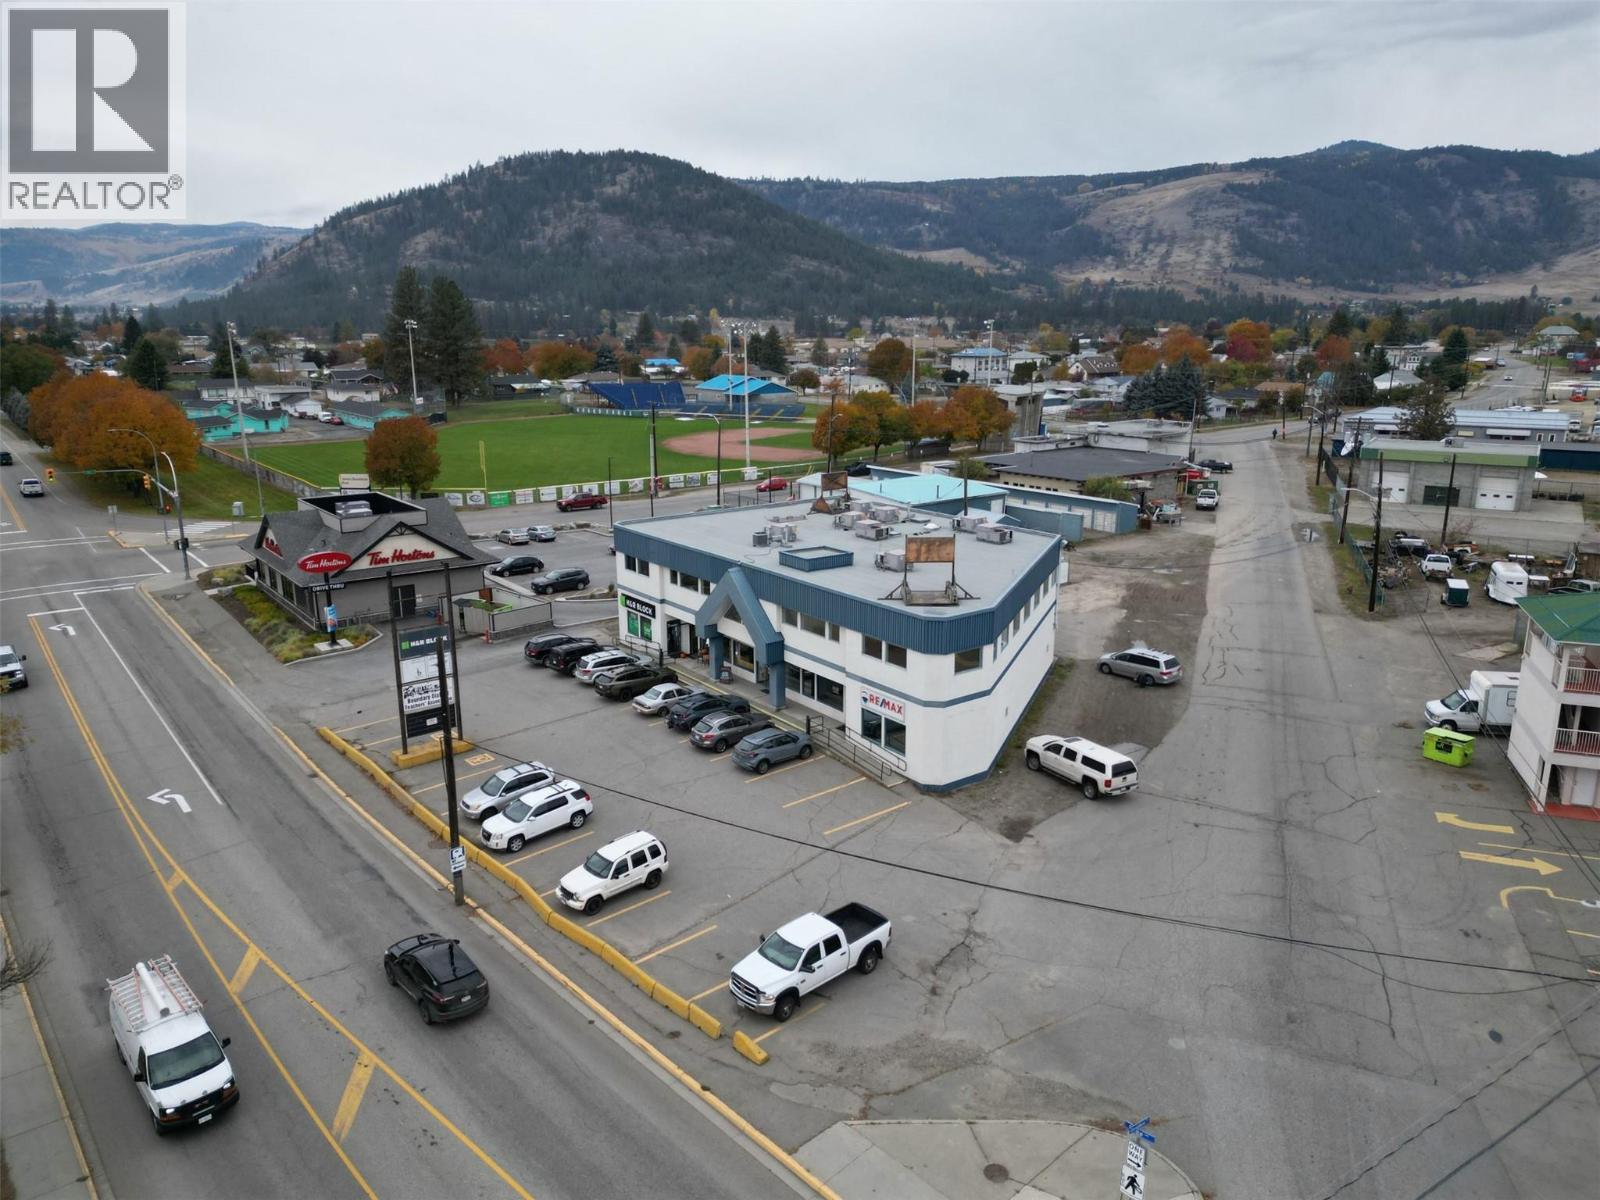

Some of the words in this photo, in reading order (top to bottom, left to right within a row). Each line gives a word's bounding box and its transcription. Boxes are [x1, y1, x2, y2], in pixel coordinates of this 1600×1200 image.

[305, 560, 319, 569] Tim
[319, 558, 347, 568] Hortons
[367, 551, 390, 566] Tim
[391, 549, 436, 563] Hortons
[312, 585, 329, 593] DRIVE
[636, 602, 653, 615] BLOCK
[869, 694, 903, 715] RE/MAX
[1129, 1143, 1143, 1155] ONE
[1128, 1150, 1143, 1163] WAY
